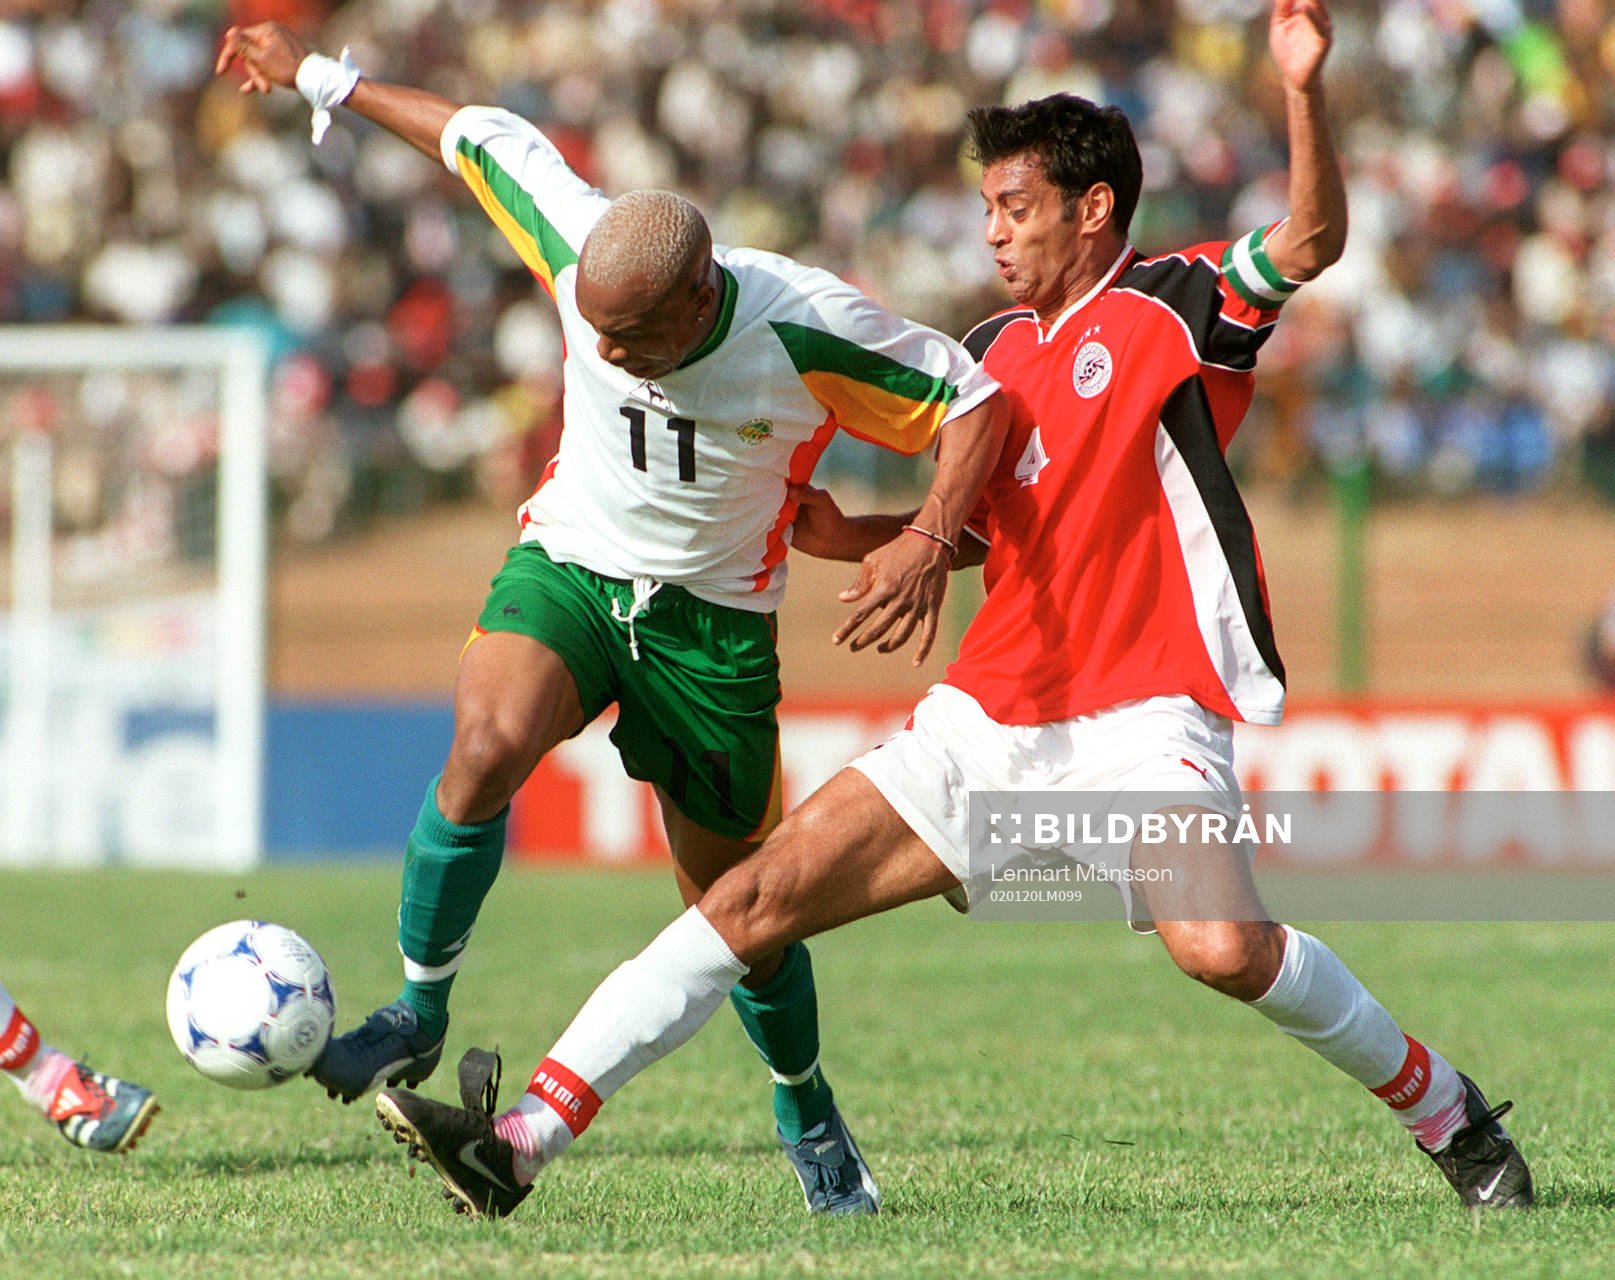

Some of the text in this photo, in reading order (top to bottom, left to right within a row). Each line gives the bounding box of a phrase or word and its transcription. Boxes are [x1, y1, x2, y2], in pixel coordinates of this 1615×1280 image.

[619, 406, 696, 483] 11
[1014, 425, 1051, 489] 4
[660, 735, 736, 819] 11
[534, 1071, 582, 1113] PUMA
